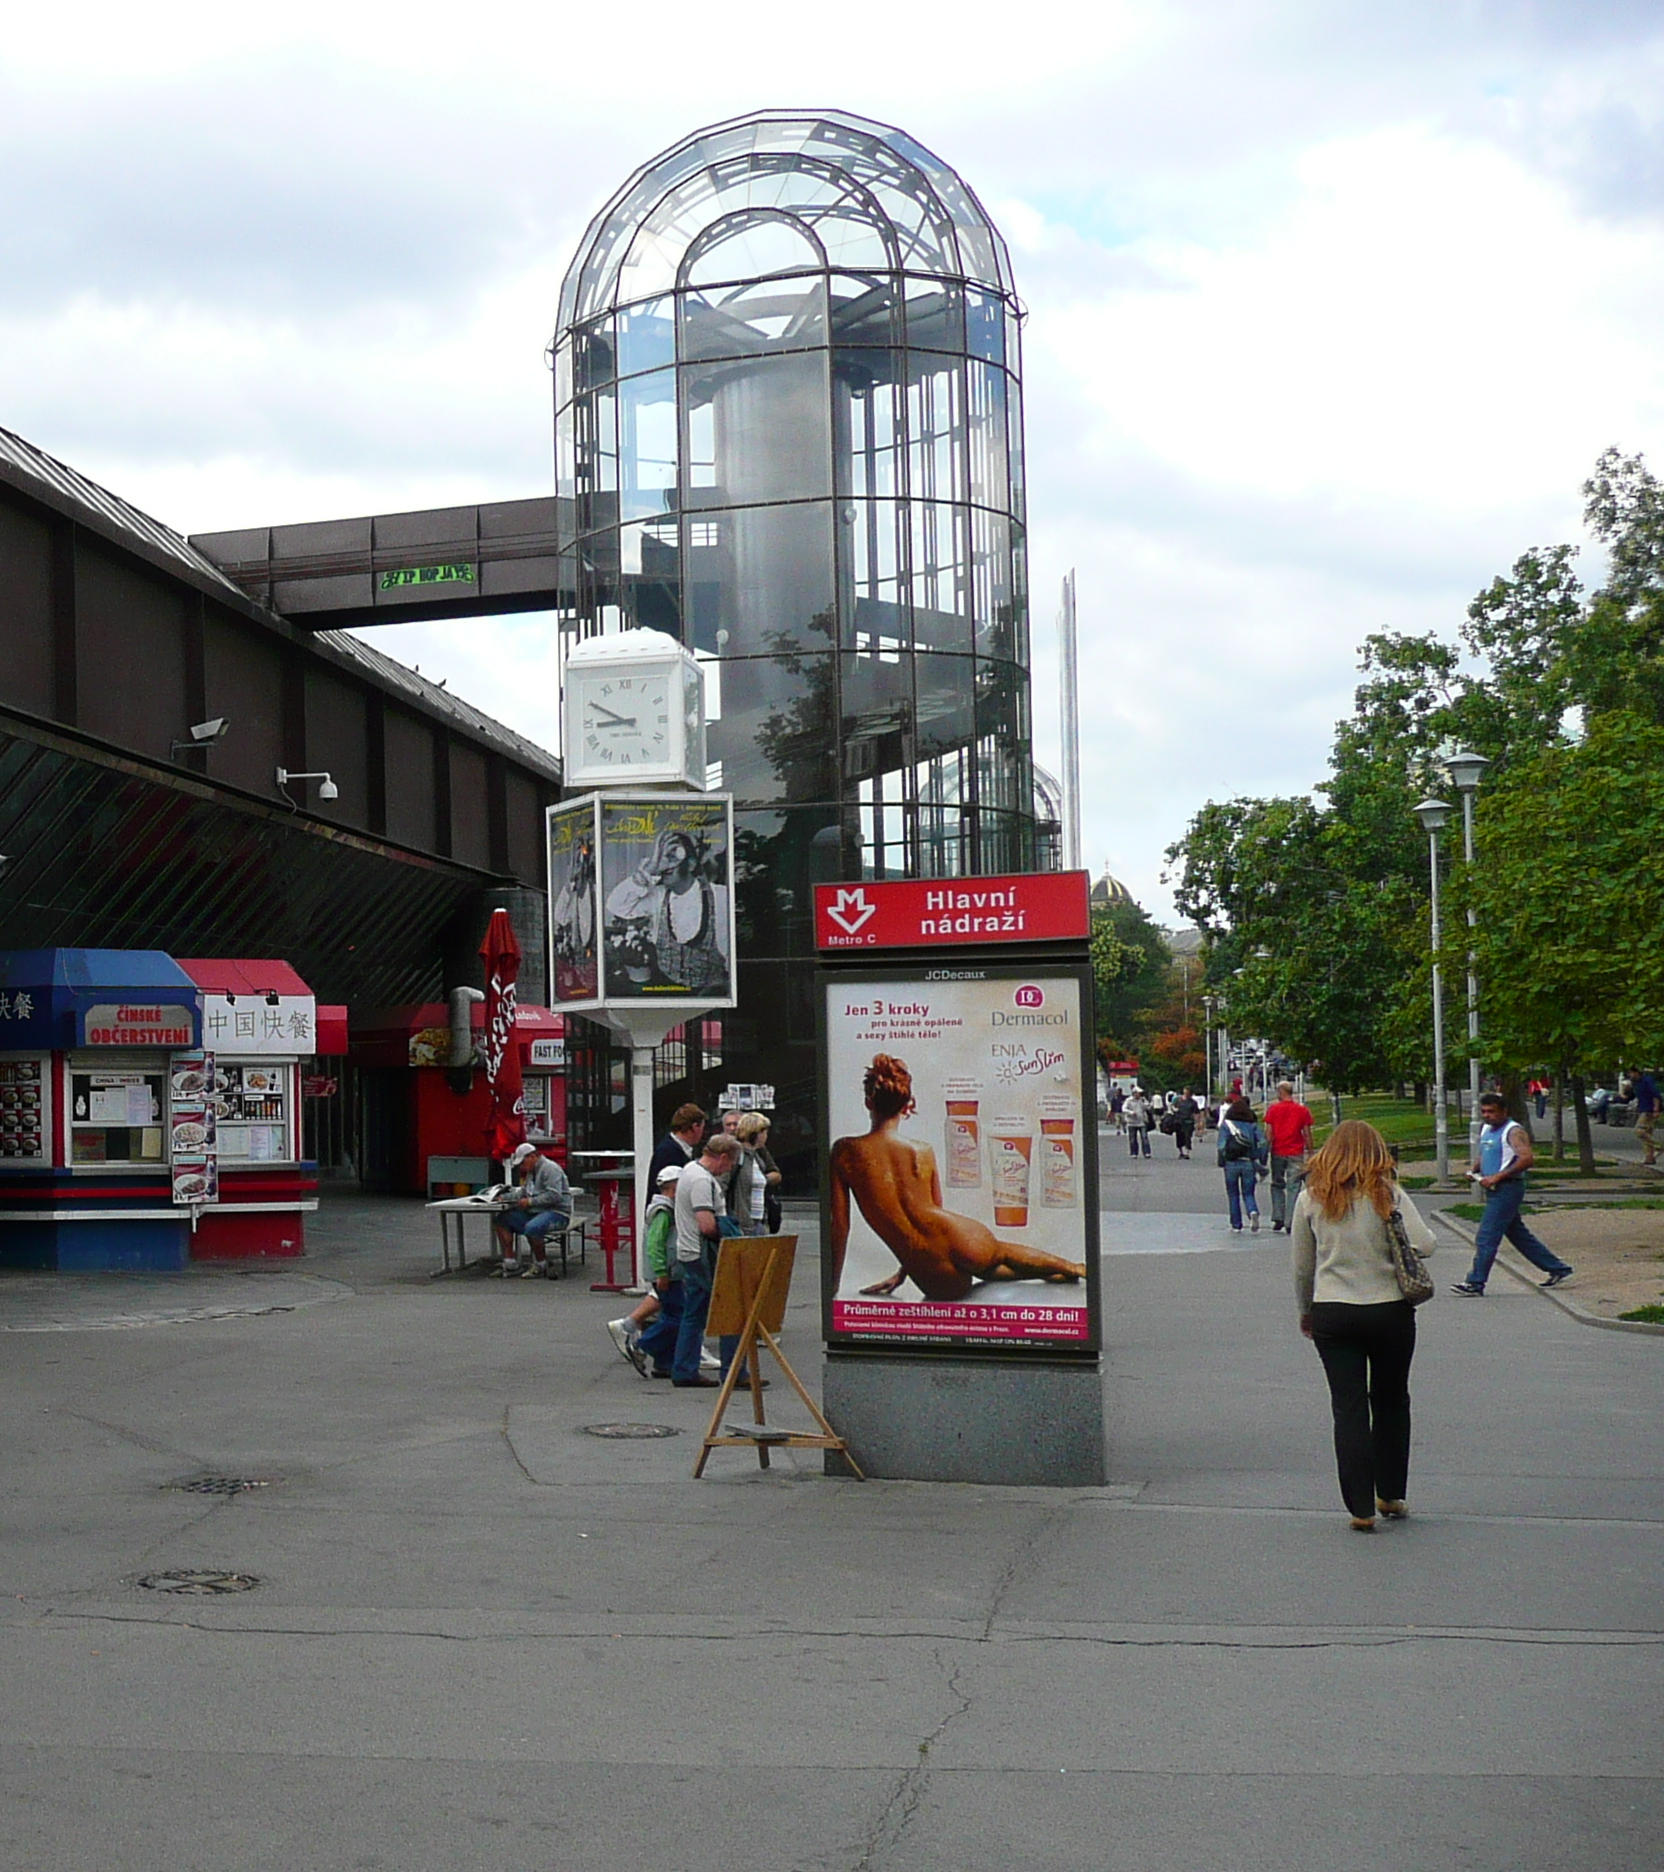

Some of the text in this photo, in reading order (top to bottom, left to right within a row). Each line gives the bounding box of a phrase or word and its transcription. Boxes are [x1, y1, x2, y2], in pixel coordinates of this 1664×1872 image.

[619, 680, 632, 690] XII
[926, 887, 1017, 911] Hlavní
[920, 910, 1025, 935] nádraží
[828, 934, 876, 946] Metro C
[925, 970, 986, 981] JCDecaux
[116, 1005, 163, 1024] ČÍNSKÉ
[844, 1001, 929, 1017] Jen 3 kroky
[207, 1008, 312, 1040] 中国快餐
[871, 1017, 963, 1029] pro krásné opálené
[991, 1010, 1068, 1027] Dermacol
[90, 1023, 190, 1044] OBČERSTVENÍ
[864, 1032, 886, 1041] sexy
[889, 1030, 916, 1039] štíhlé
[918, 1030, 941, 1039] tělo!
[534, 1044, 552, 1058] FAST
[991, 1044, 1027, 1058] ENJA
[843, 1304, 896, 1316] Průměrné
[898, 1306, 951, 1318] zeštíhlení
[954, 1308, 966, 1318] až
[980, 1308, 996, 1320] 3,1
[1000, 1310, 1017, 1319] cm
[1020, 1309, 1035, 1320] do
[1038, 1310, 1053, 1321] 28
